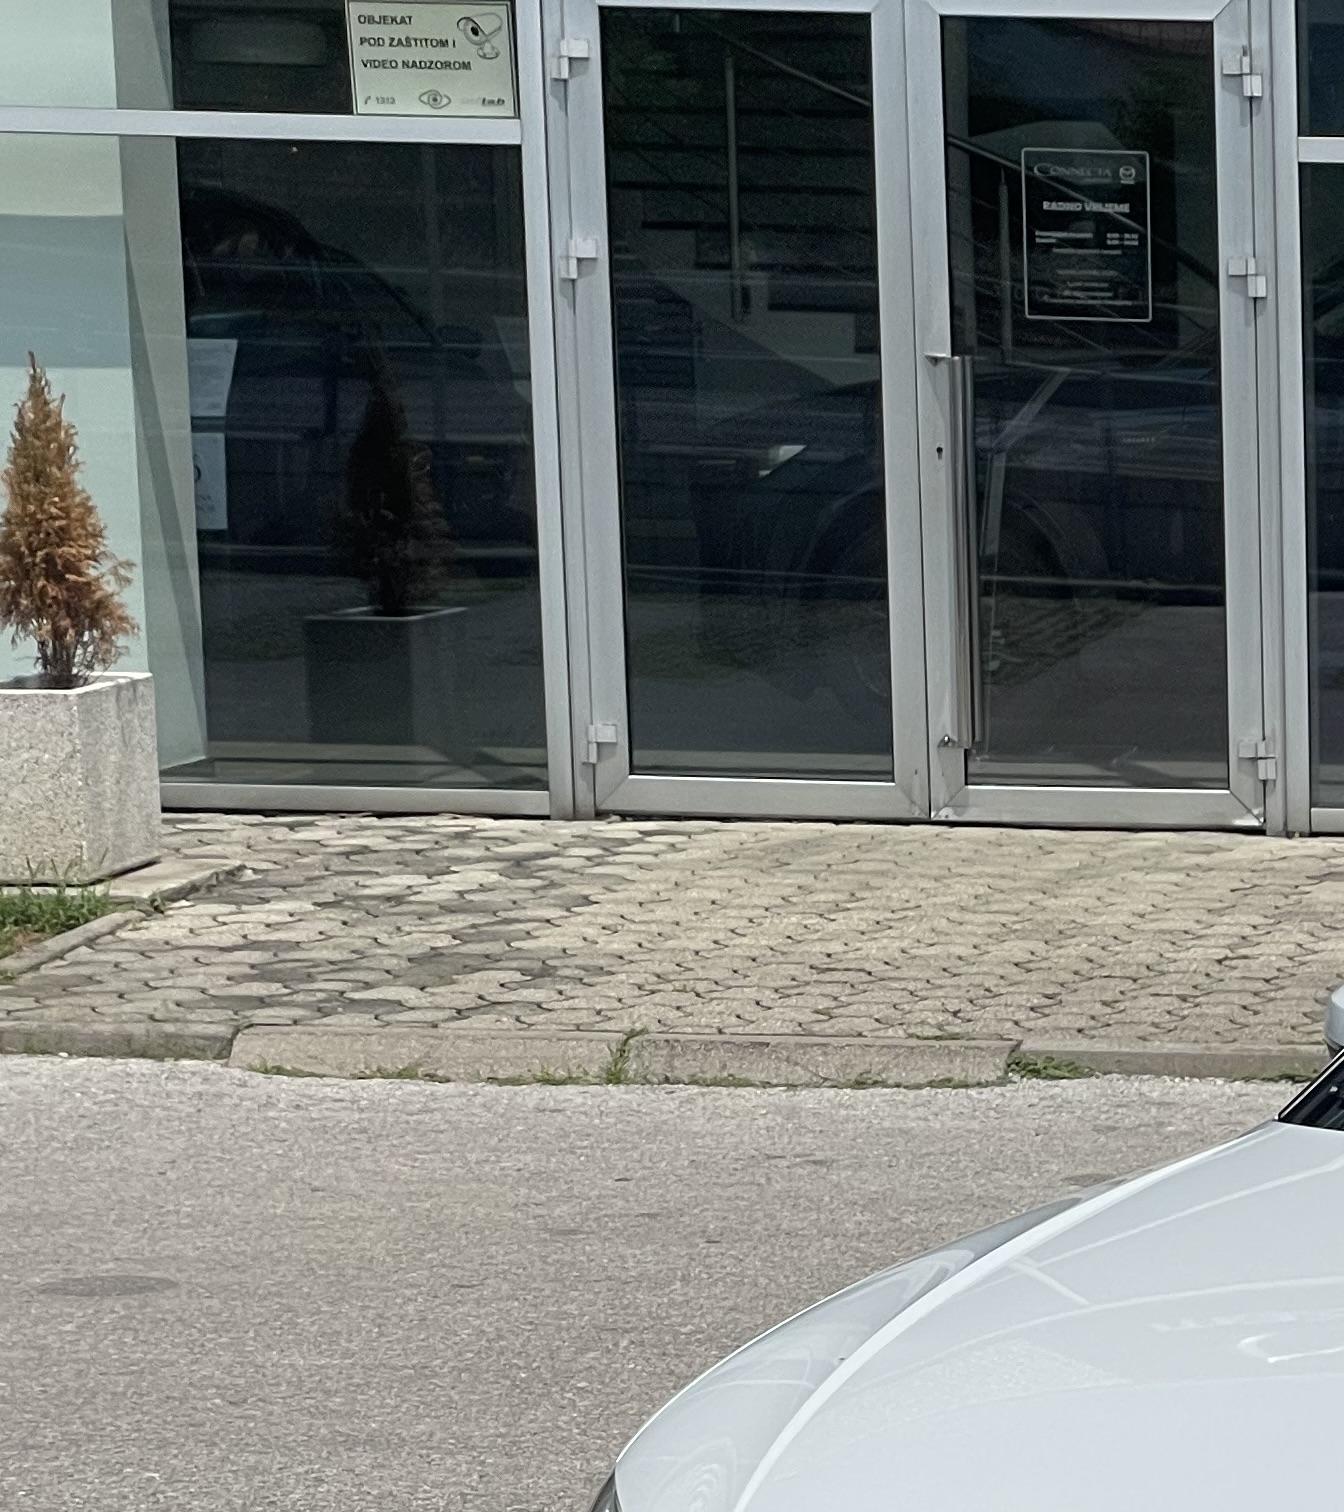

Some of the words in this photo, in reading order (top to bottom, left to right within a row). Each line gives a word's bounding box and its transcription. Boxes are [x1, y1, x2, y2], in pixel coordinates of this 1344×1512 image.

[357, 14, 413, 25] OBJEKAT
[359, 36, 385, 47] POD
[389, 36, 449, 48] ZAŠTITOM
[453, 39, 456, 48] I
[361, 59, 399, 69] VIDEO
[402, 60, 472, 71] NADZOROM
